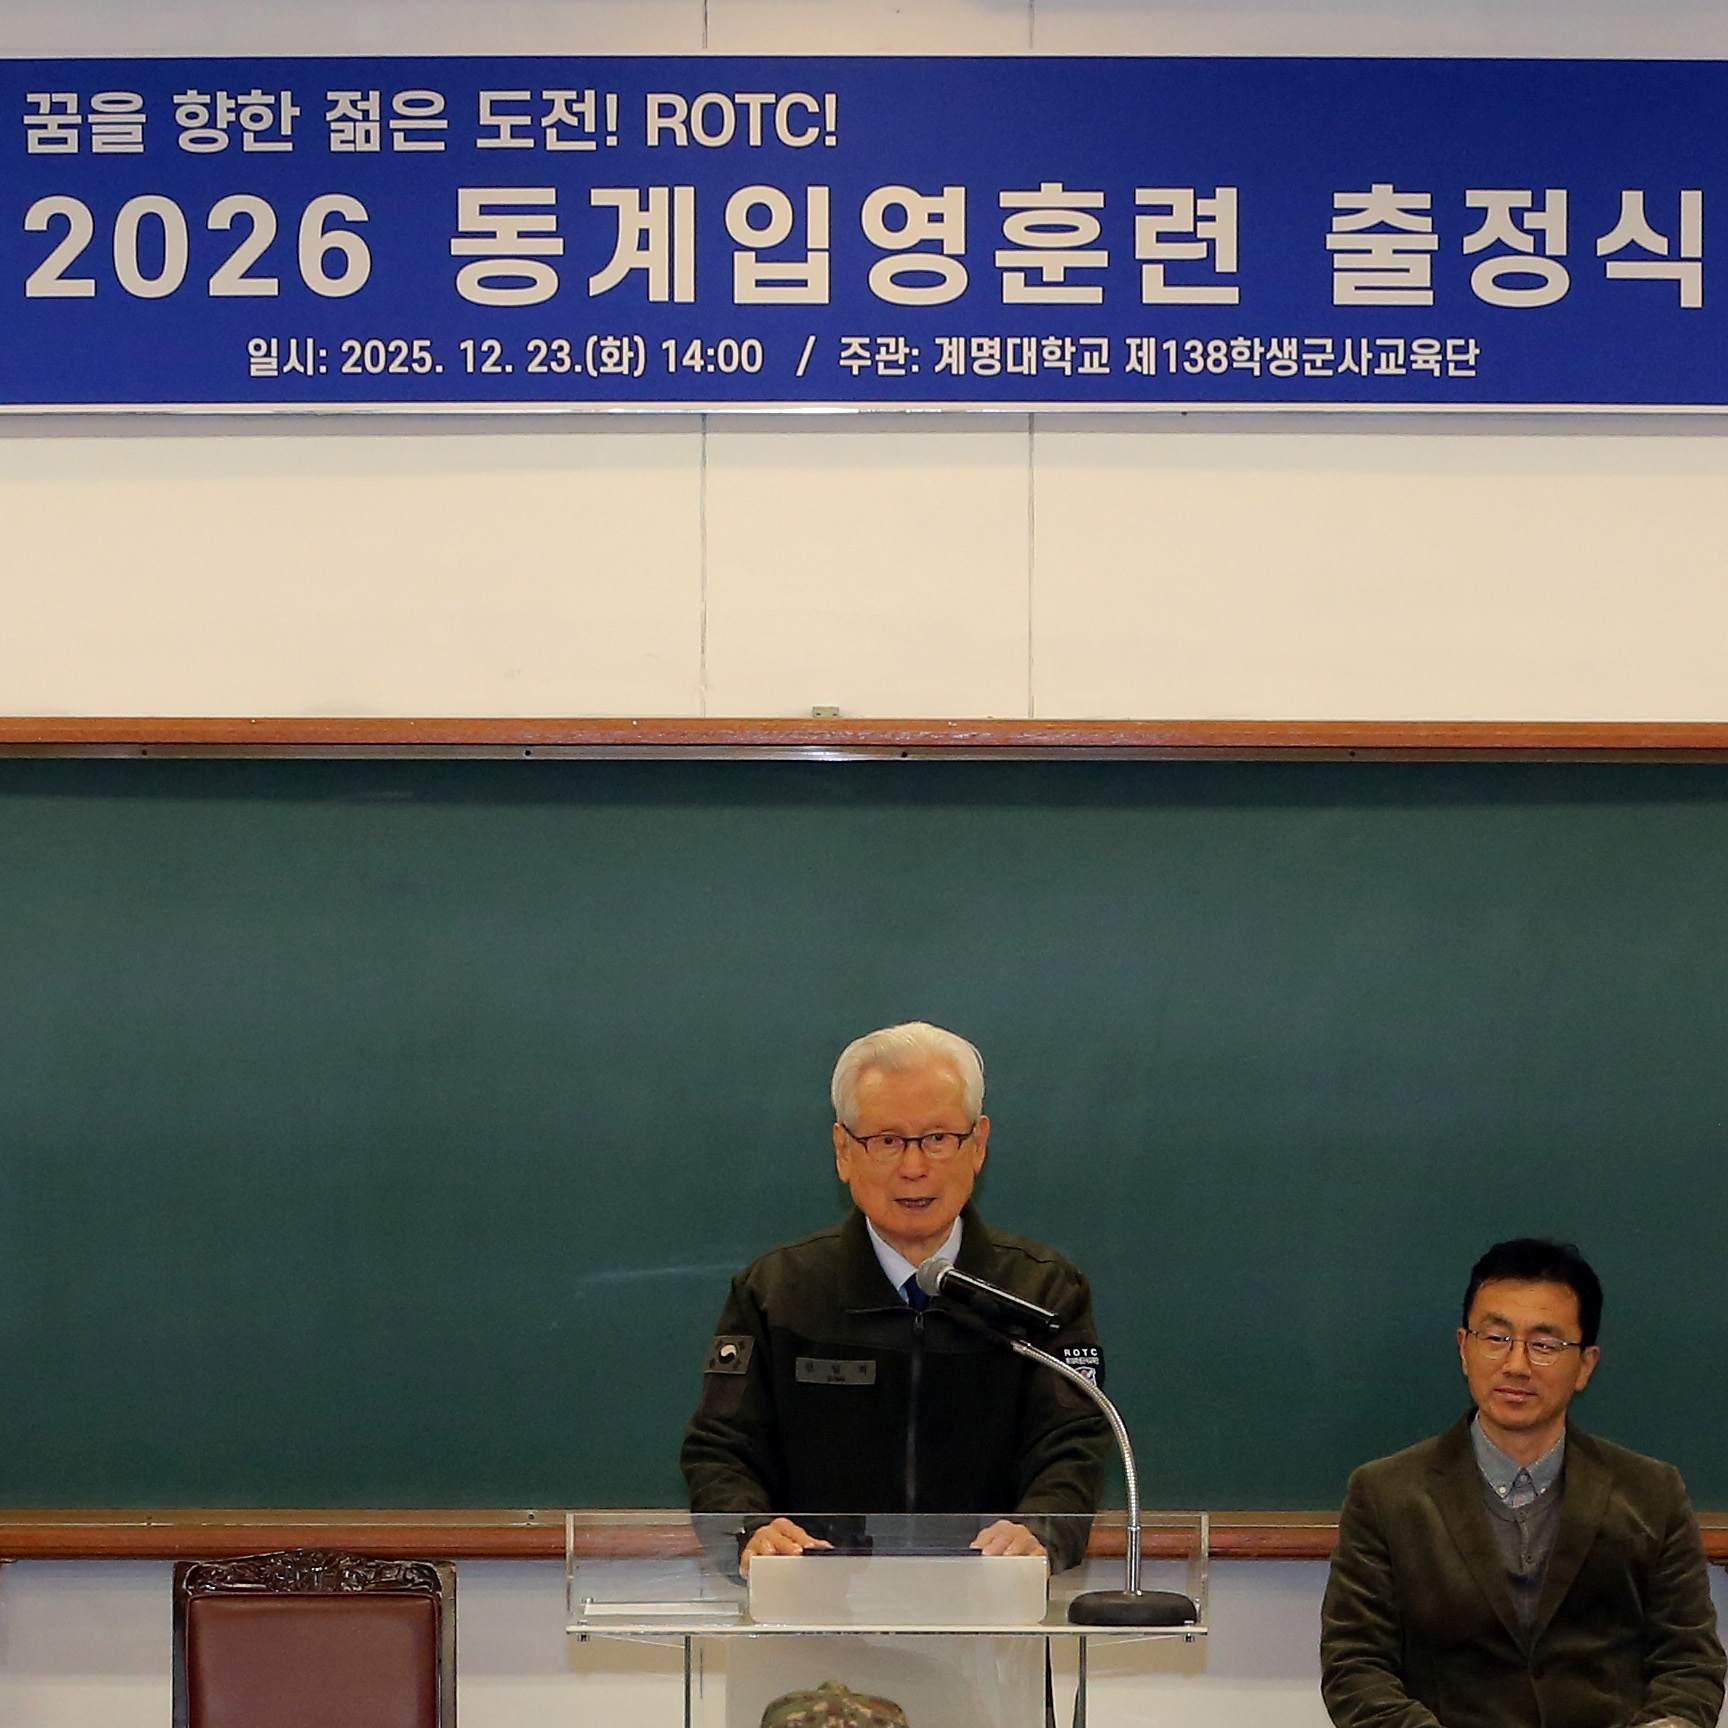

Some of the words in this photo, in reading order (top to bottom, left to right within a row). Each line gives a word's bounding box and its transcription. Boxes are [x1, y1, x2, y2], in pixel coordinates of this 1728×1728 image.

[23, 90, 147, 155] 꿈을
[172, 88, 302, 154] 향한
[324, 89, 449, 153] 젊은
[475, 88, 619, 153] 도전!
[645, 91, 838, 149] ROTC!
[23, 192, 373, 299] 2026
[449, 181, 1241, 308] 동계입영훈련
[1325, 182, 1704, 310] 출정식
[246, 336, 328, 378] 일시:
[340, 338, 444, 375] 2025.
[458, 338, 514, 375] 12.
[526, 335, 647, 378] 23.(화)
[661, 337, 764, 374] 14:00
[795, 334, 817, 378] /
[838, 335, 920, 377] 주관:
[933, 334, 1111, 377] 계명대학교
[1124, 335, 1482, 378] 제138학생군사교육단
[1063, 1348, 1099, 1357] ROTC
